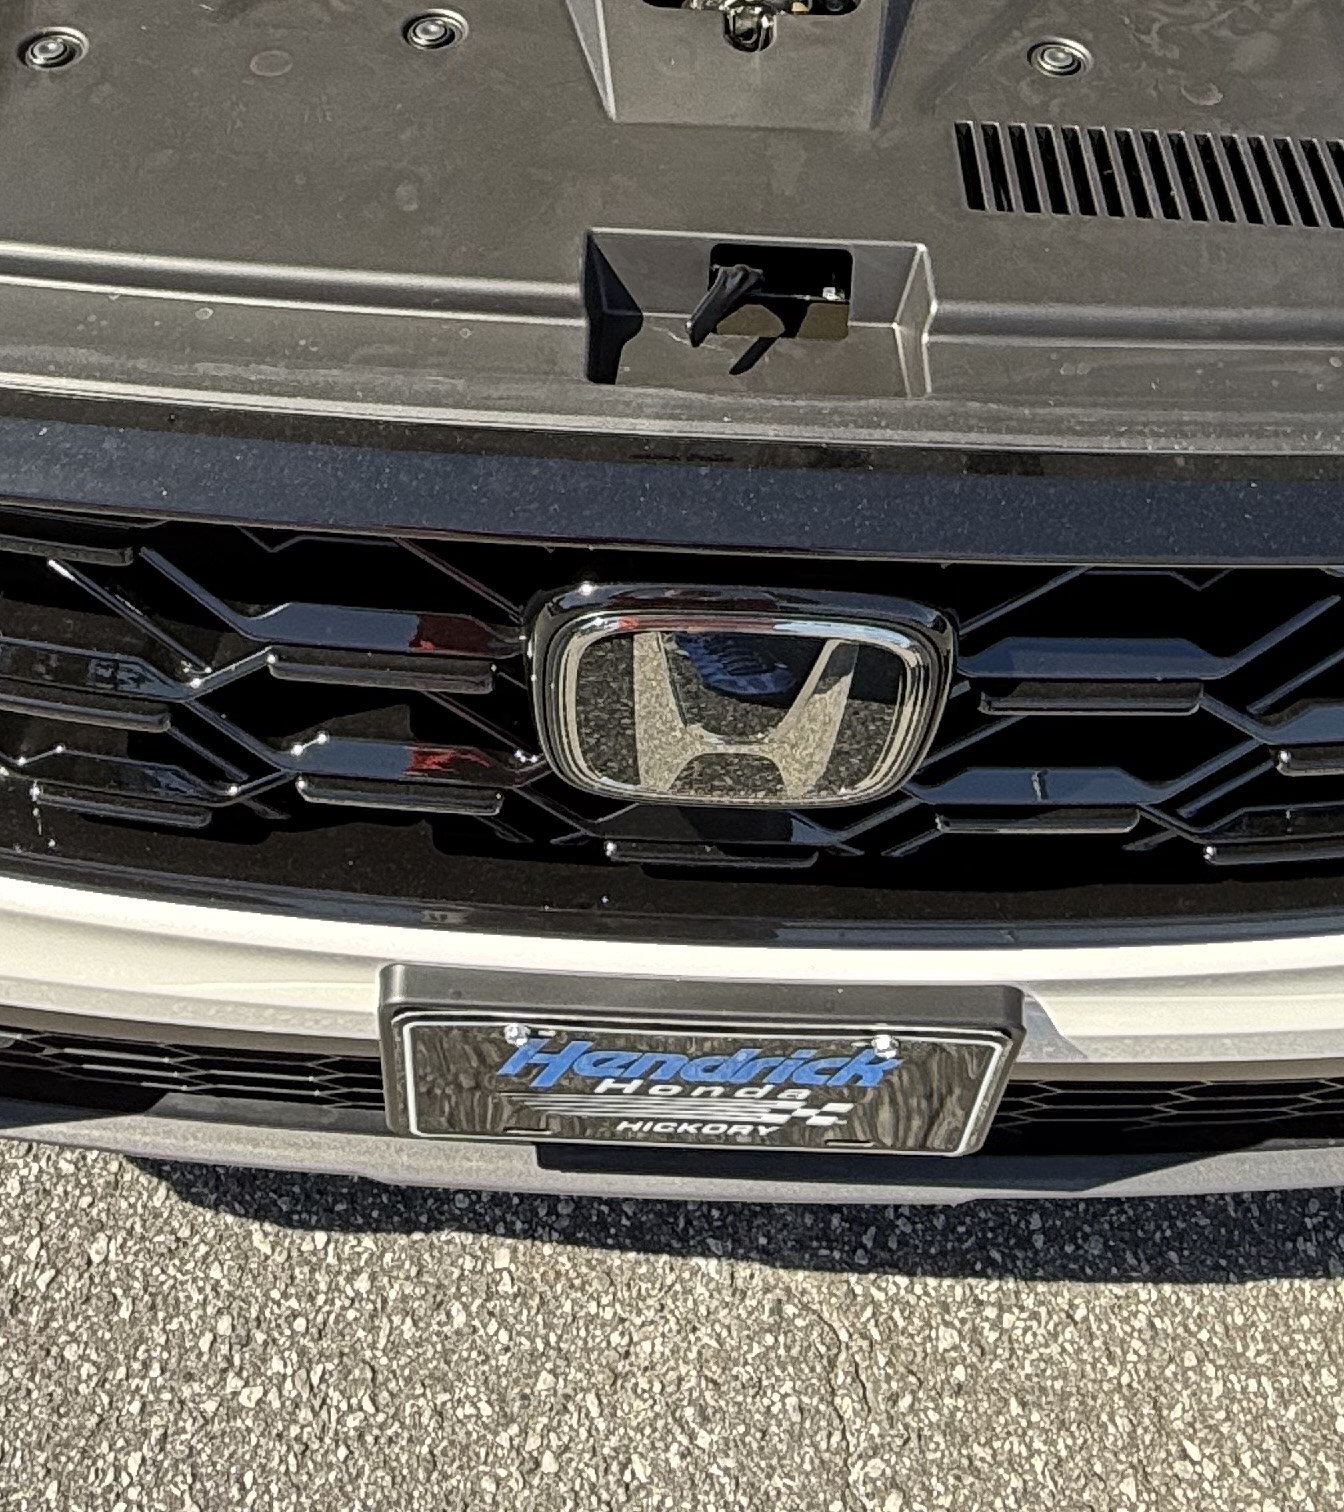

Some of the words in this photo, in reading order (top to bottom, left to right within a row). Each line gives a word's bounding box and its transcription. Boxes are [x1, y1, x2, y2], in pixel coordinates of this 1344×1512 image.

[633, 631, 860, 796] H
[497, 1037, 904, 1088] Hendrick
[593, 1078, 812, 1100] Honda
[615, 1120, 780, 1137] HICKORY
